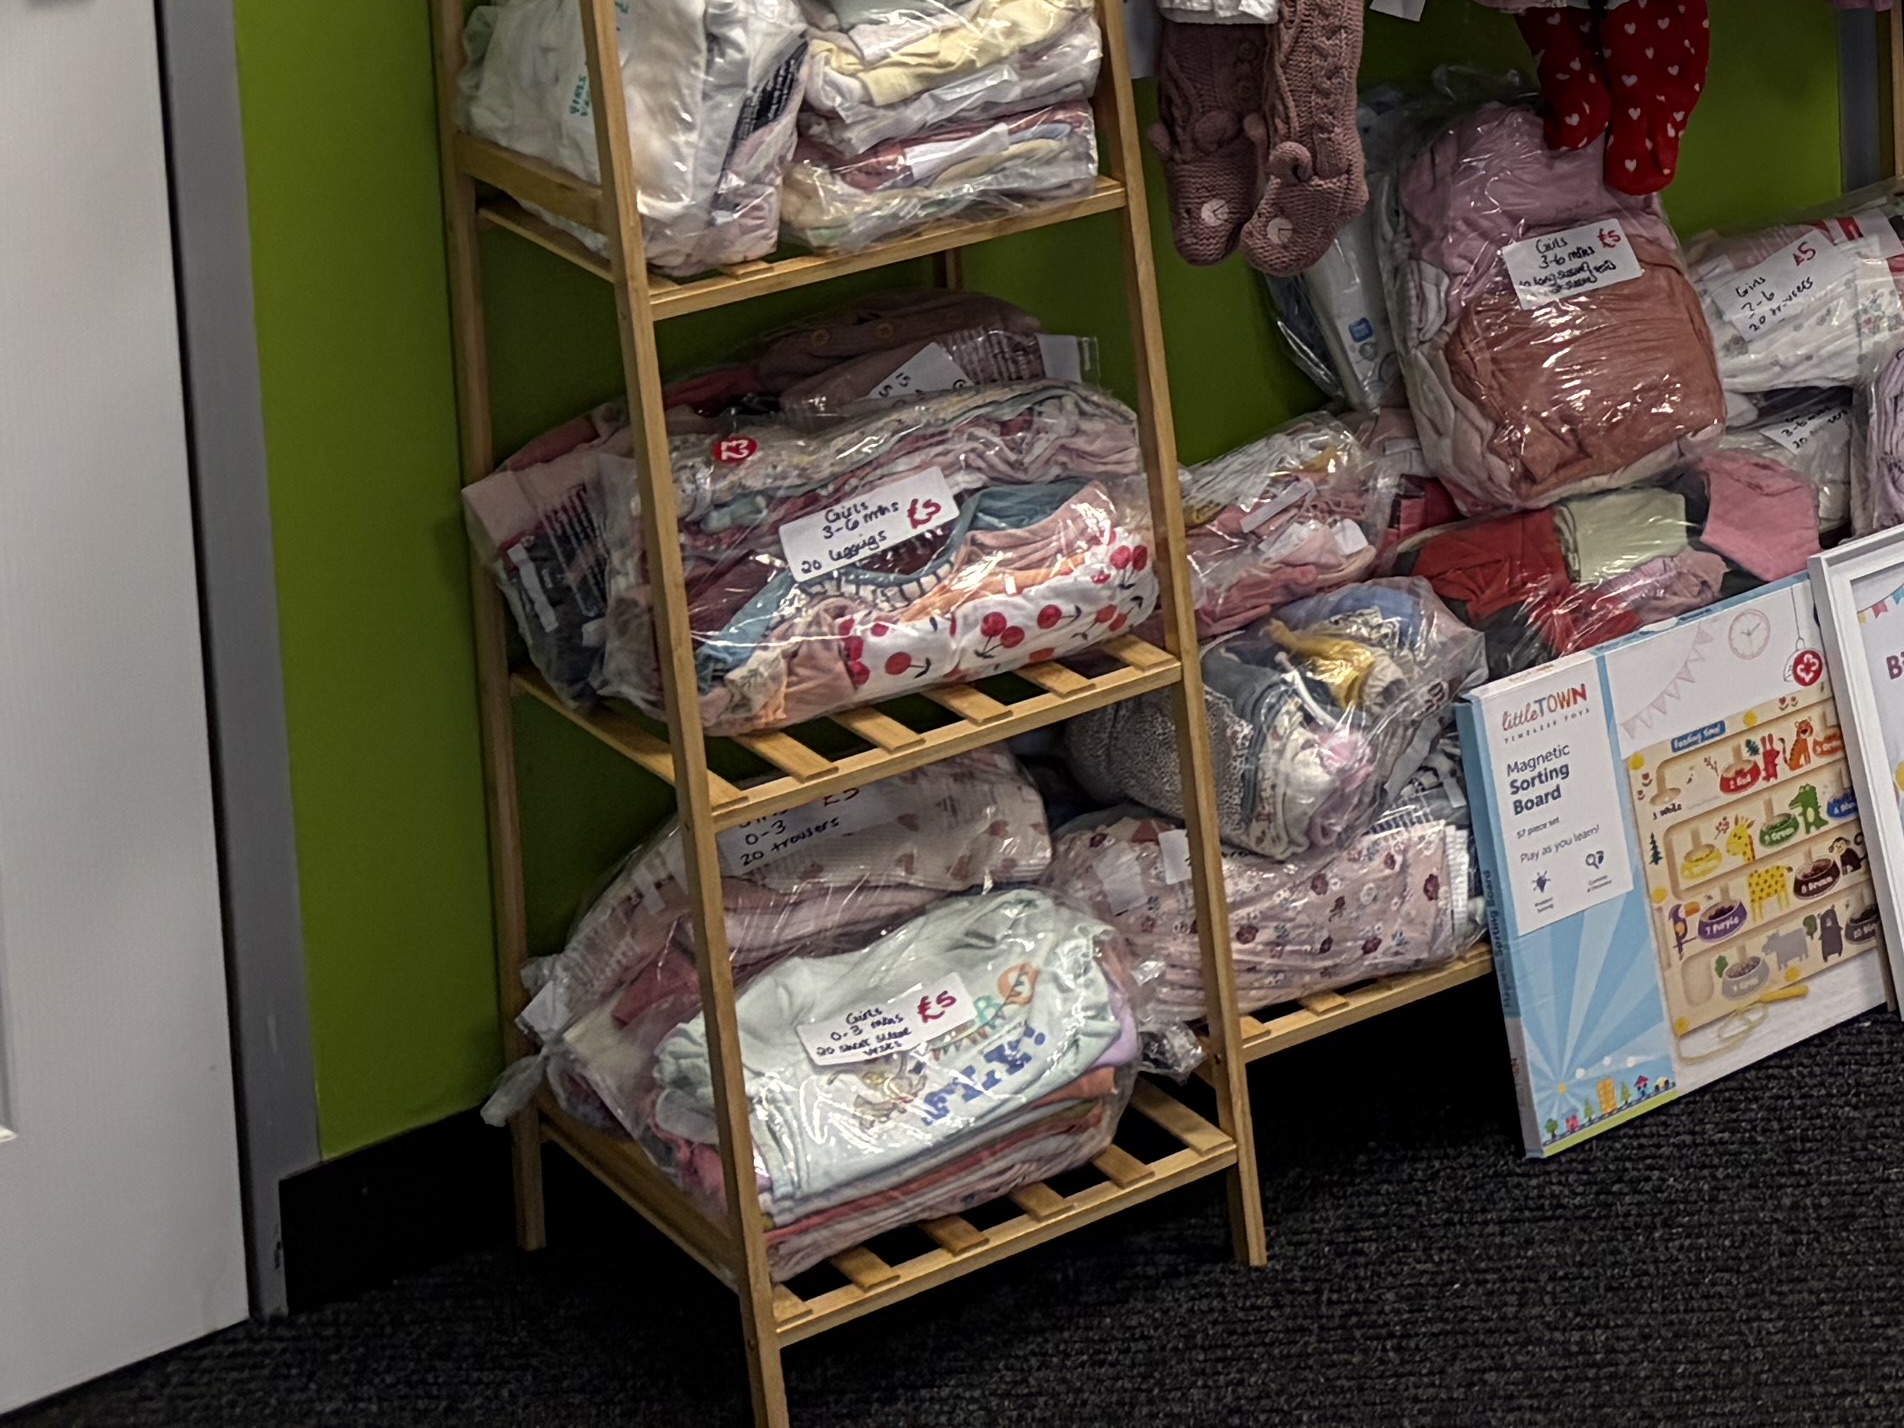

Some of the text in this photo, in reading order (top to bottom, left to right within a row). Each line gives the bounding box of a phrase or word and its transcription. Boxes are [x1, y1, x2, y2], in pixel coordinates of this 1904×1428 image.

[825, 501, 869, 524] Girls
[907, 498, 941, 530] £5
[1507, 744, 1571, 777] Magnetic
[1510, 764, 1570, 795] Sorting
[1512, 785, 1562, 816] Board
